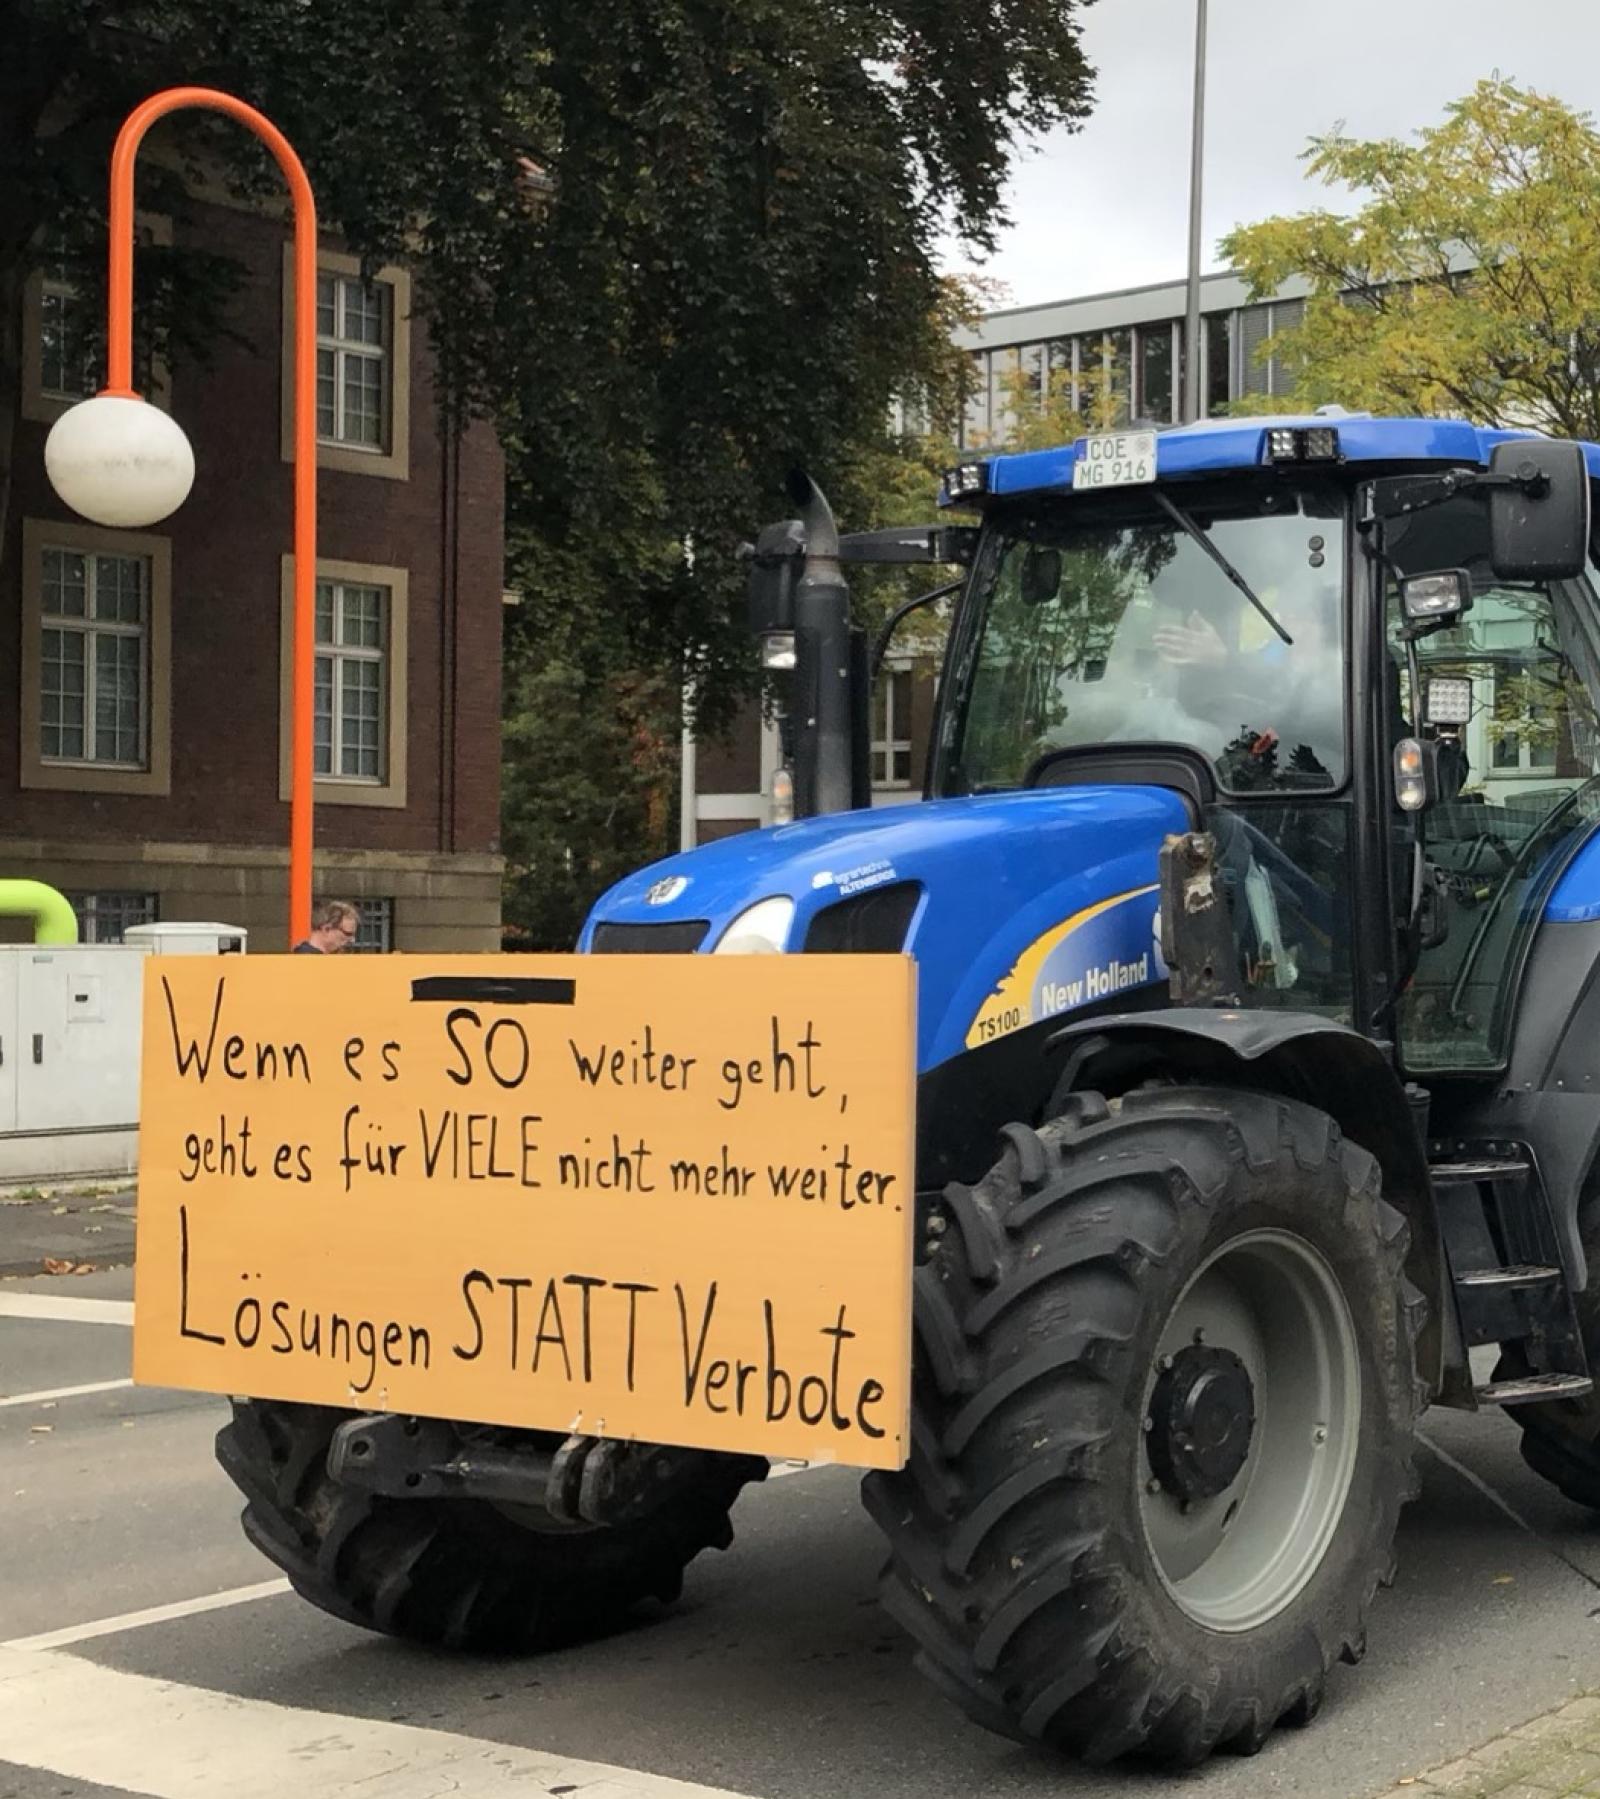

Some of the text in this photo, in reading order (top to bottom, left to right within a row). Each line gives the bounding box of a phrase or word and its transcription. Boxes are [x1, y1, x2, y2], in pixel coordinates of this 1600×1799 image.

[1080, 459, 1147, 486] MG 916
[1090, 438, 1127, 461] COE
[1041, 951, 1149, 1017] New Holland
[162, 976, 311, 1084] Wenn
[343, 1037, 401, 1082] es
[445, 1007, 530, 1089] SO
[569, 1025, 697, 1091] weiter
[977, 1007, 1021, 1042] TS100
[180, 1114, 258, 1182] geht
[273, 1143, 312, 1183] es
[339, 1105, 407, 1192] für
[419, 1109, 543, 1190] VIELE
[558, 1134, 655, 1194] nicht
[670, 1145, 756, 1198] mehr
[179, 1206, 431, 1394] Lösungen
[452, 1268, 658, 1394] STATT
